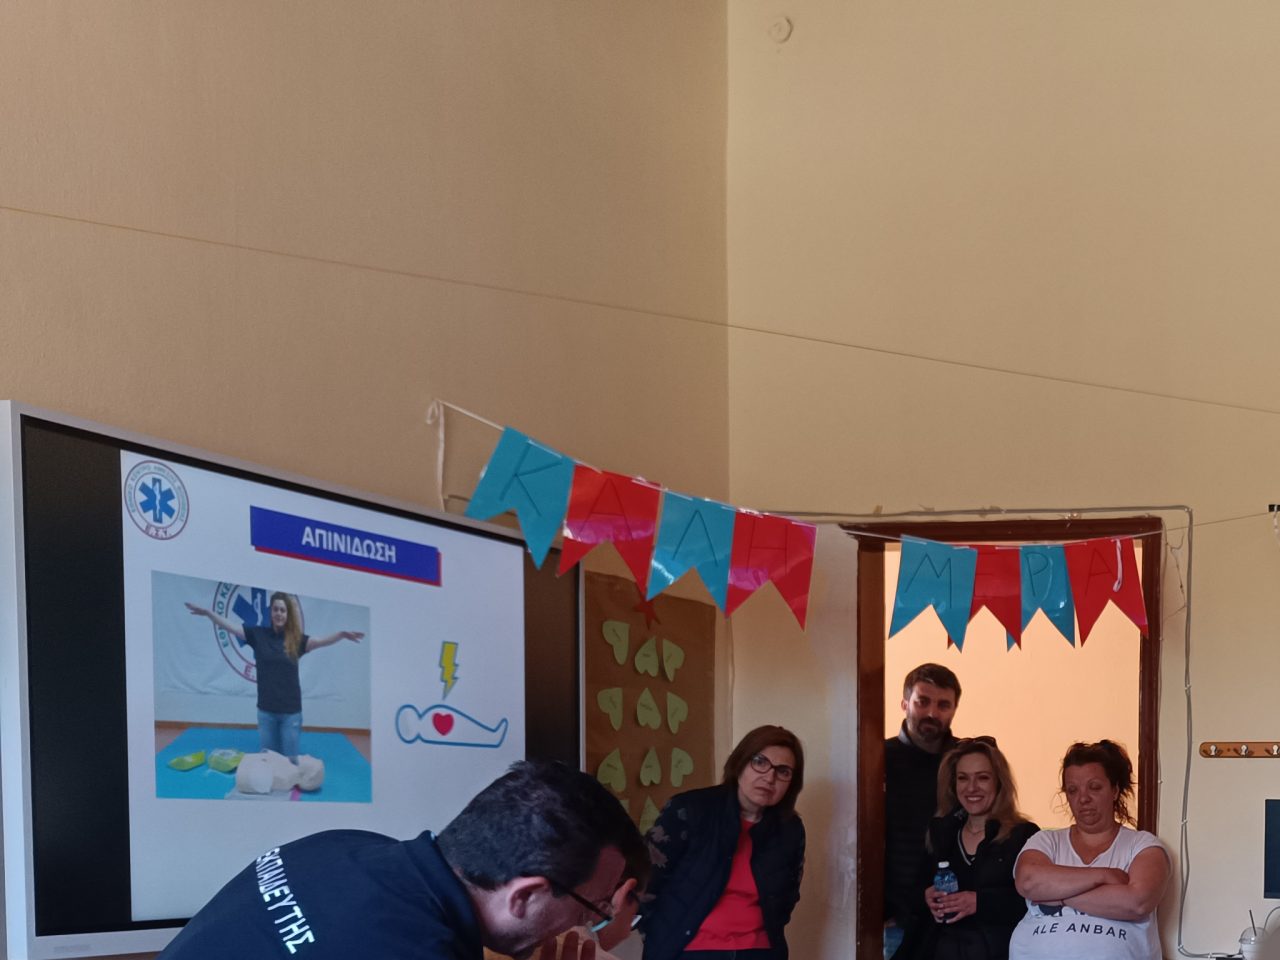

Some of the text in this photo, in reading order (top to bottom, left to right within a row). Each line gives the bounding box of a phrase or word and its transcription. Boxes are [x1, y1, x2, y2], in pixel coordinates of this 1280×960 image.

[301, 526, 396, 563] ΑΠΙΝΙΔΩΣΗ
[1032, 922, 1128, 941] ALE ANBAR
